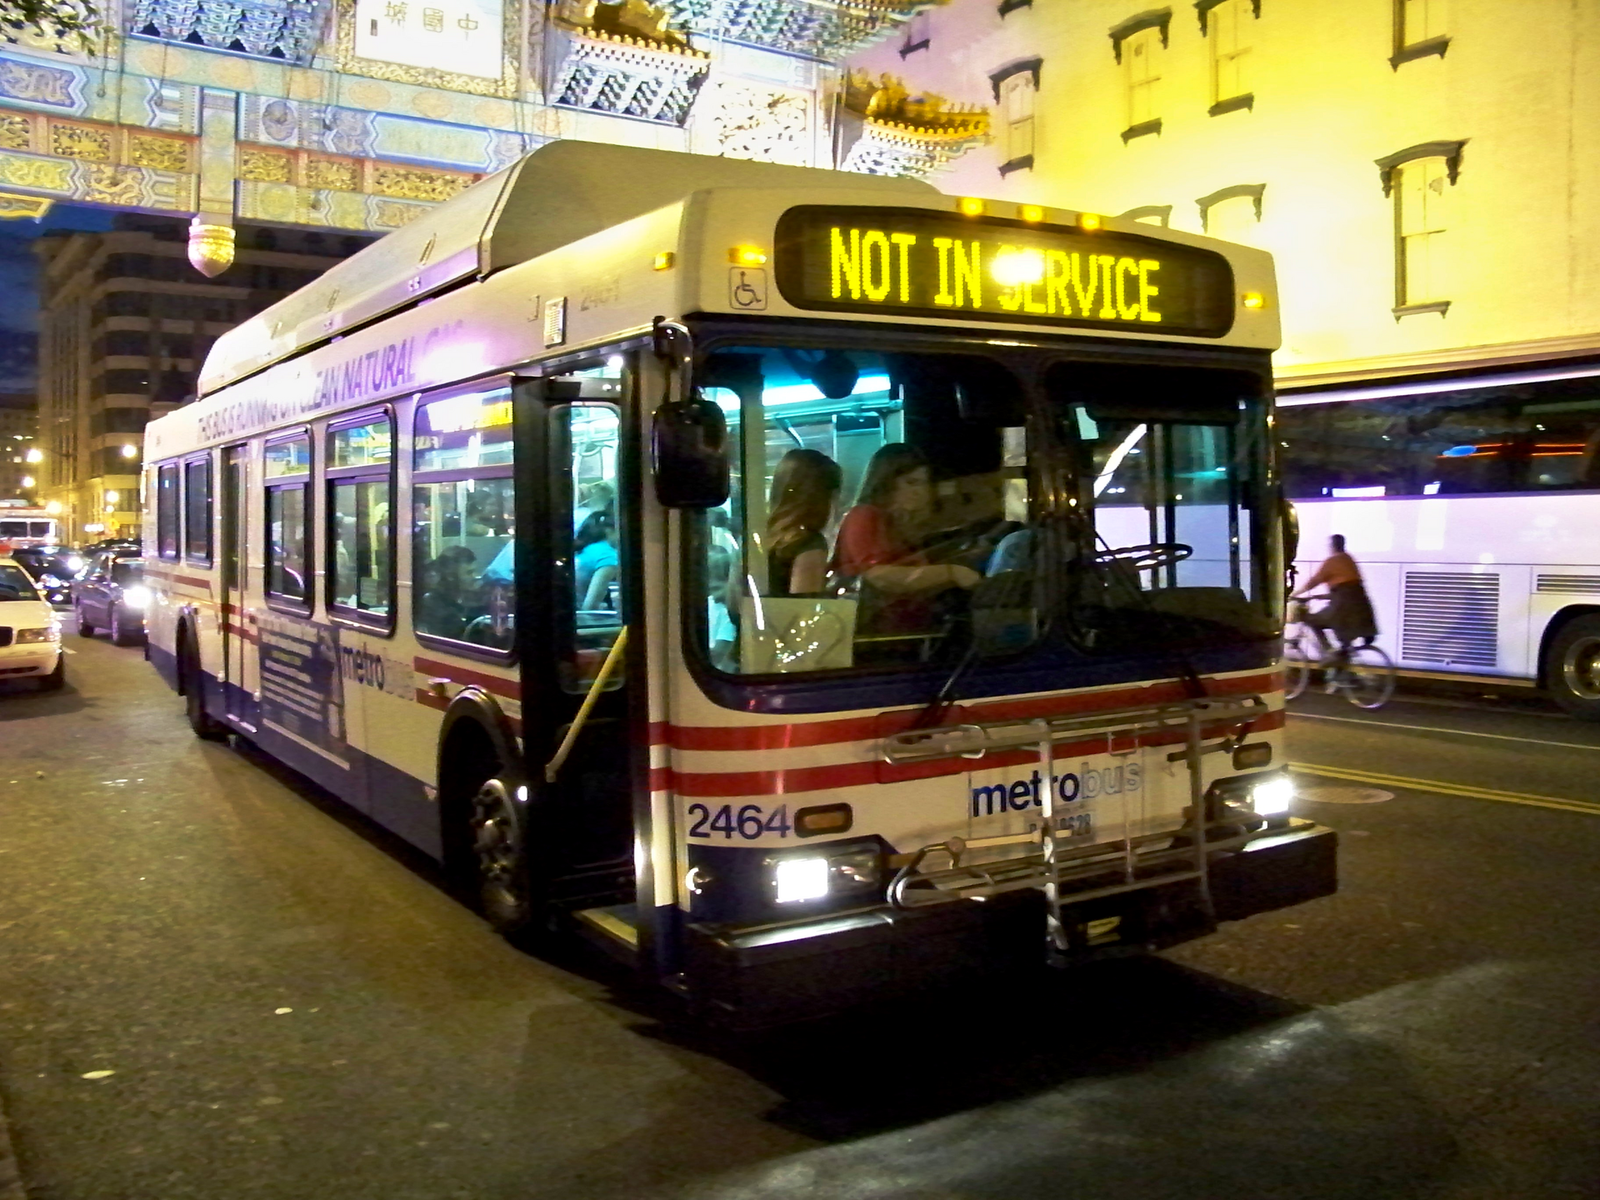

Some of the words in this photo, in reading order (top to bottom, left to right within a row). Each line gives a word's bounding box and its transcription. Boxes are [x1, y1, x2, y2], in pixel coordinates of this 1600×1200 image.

[831, 227, 916, 304] NOT
[933, 236, 984, 310] IN
[341, 334, 416, 402] NATURAL
[688, 802, 791, 840] 2464
